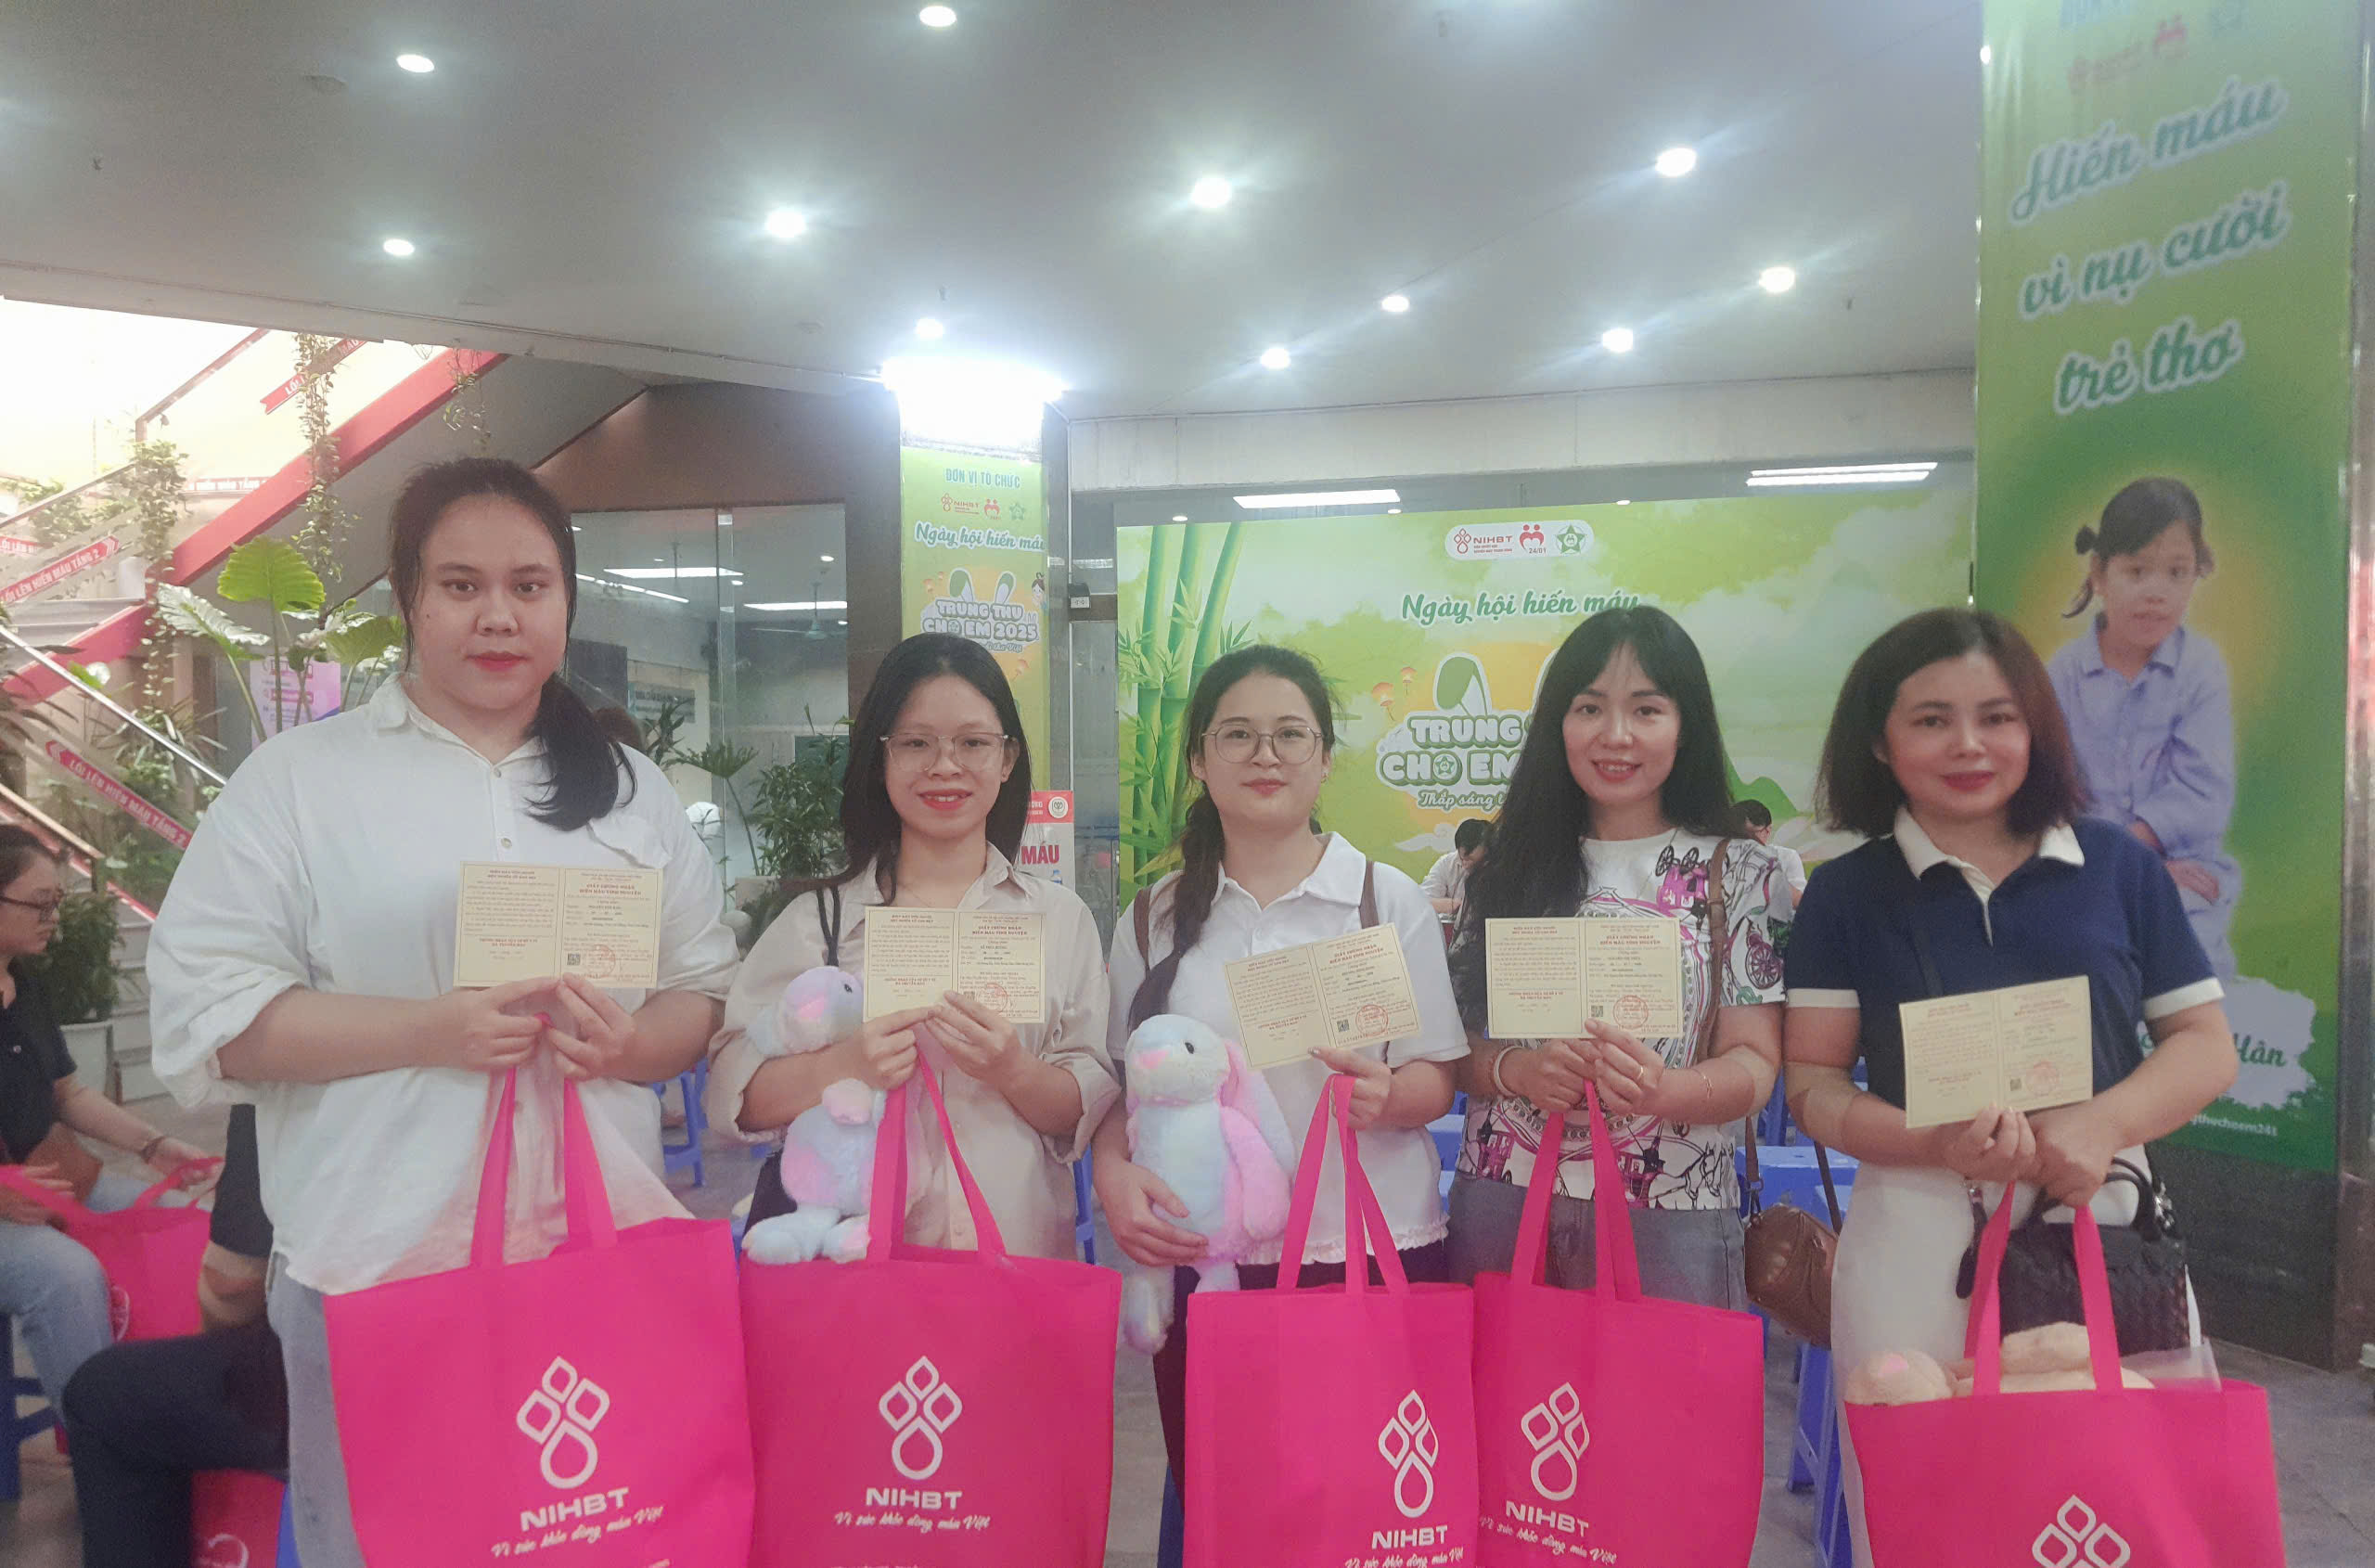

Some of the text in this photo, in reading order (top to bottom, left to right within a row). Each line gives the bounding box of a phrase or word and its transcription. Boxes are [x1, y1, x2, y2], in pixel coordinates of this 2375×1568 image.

[2011, 76, 2280, 222] Hiến máu
[2022, 184, 2288, 315] vì nụ cười
[2057, 321, 2241, 411] trẻ thơ
[945, 468, 966, 483] ĐƠN
[968, 469, 978, 487] VỊ
[916, 521, 957, 546] Ngày
[959, 528, 982, 547] hội
[985, 530, 1017, 547] hiến
[1473, 534, 1513, 544] NIHBT
[936, 599, 1024, 622] TRUNG THU
[1401, 593, 1473, 626] Ngày
[1476, 592, 1516, 621] hội
[1522, 589, 1577, 615] hiến
[922, 618, 1039, 643] CHO EM 2025
[1406, 714, 1523, 749] TRUNG
[1380, 751, 1463, 786] CHO
[1418, 789, 1456, 809] Thắp
[1457, 791, 1496, 812] sáng
[1021, 841, 1060, 865] MÁU
[520, 1486, 630, 1532] NIHBT
[865, 1486, 963, 1510] NIHBT
[1506, 1499, 1589, 1537] NIHBT
[1371, 1524, 1448, 1550] NIHBT
